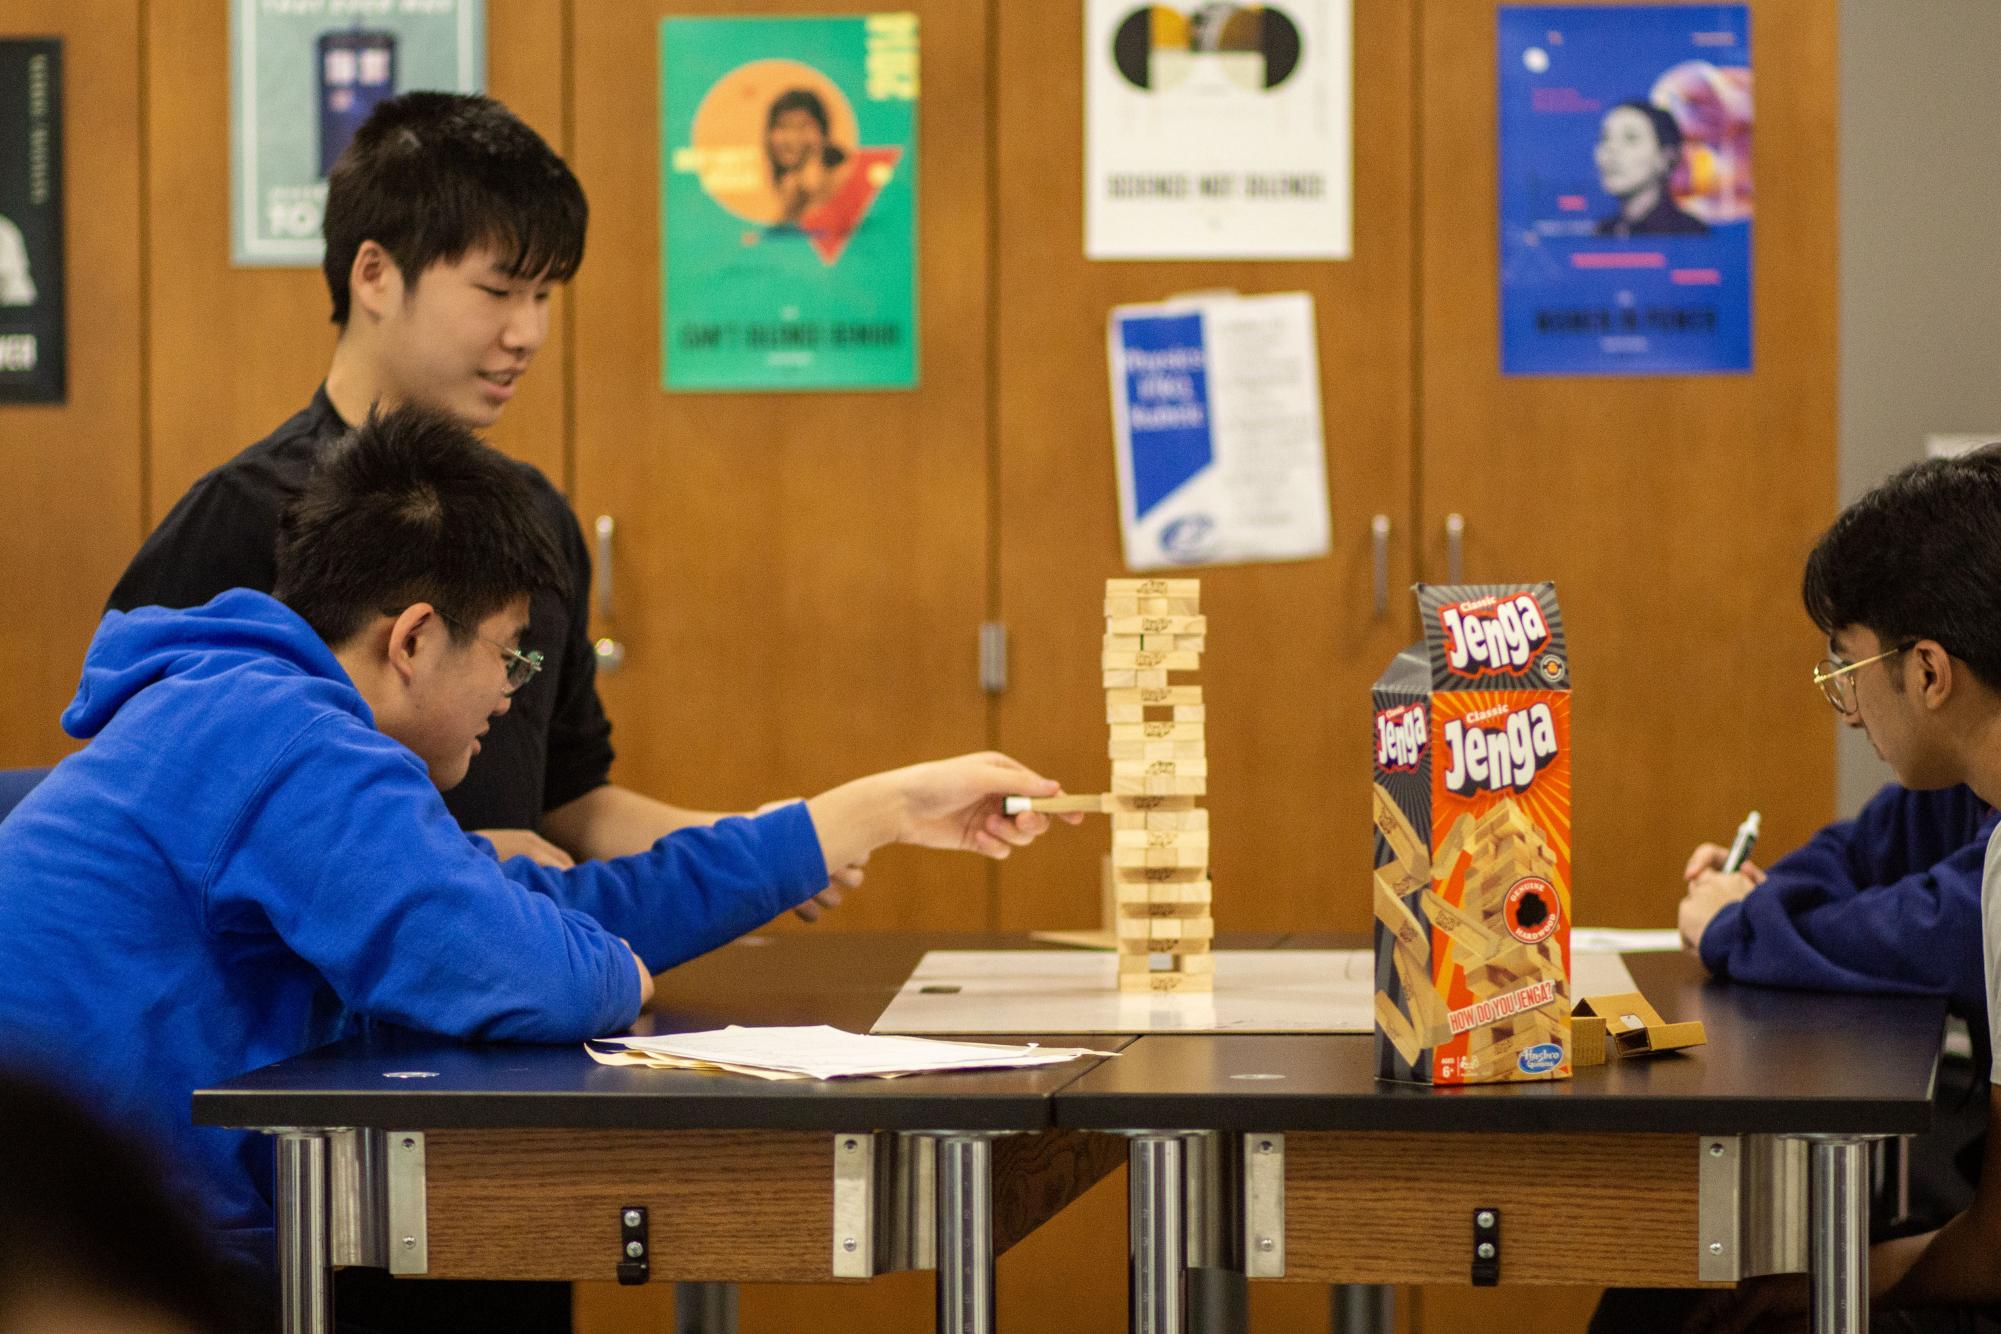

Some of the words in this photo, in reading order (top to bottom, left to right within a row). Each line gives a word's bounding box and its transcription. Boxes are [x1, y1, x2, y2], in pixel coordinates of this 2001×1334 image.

[1460, 596, 1497, 613] Classic
[1443, 596, 1547, 669] Jenga
[1465, 703, 1509, 724] Classic
[1377, 707, 1427, 766] Jenga
[1444, 703, 1558, 790] Jenga
[1509, 882, 1545, 902] GENUINE
[1515, 913, 1556, 940] HARDWOOD
[1449, 1012, 1475, 1032] HOW
[1477, 1004, 1492, 1023] DO
[1493, 996, 1515, 1018] YOU
[1516, 982, 1553, 1009] JENGA?
[1520, 1047, 1560, 1061] Hasbro
